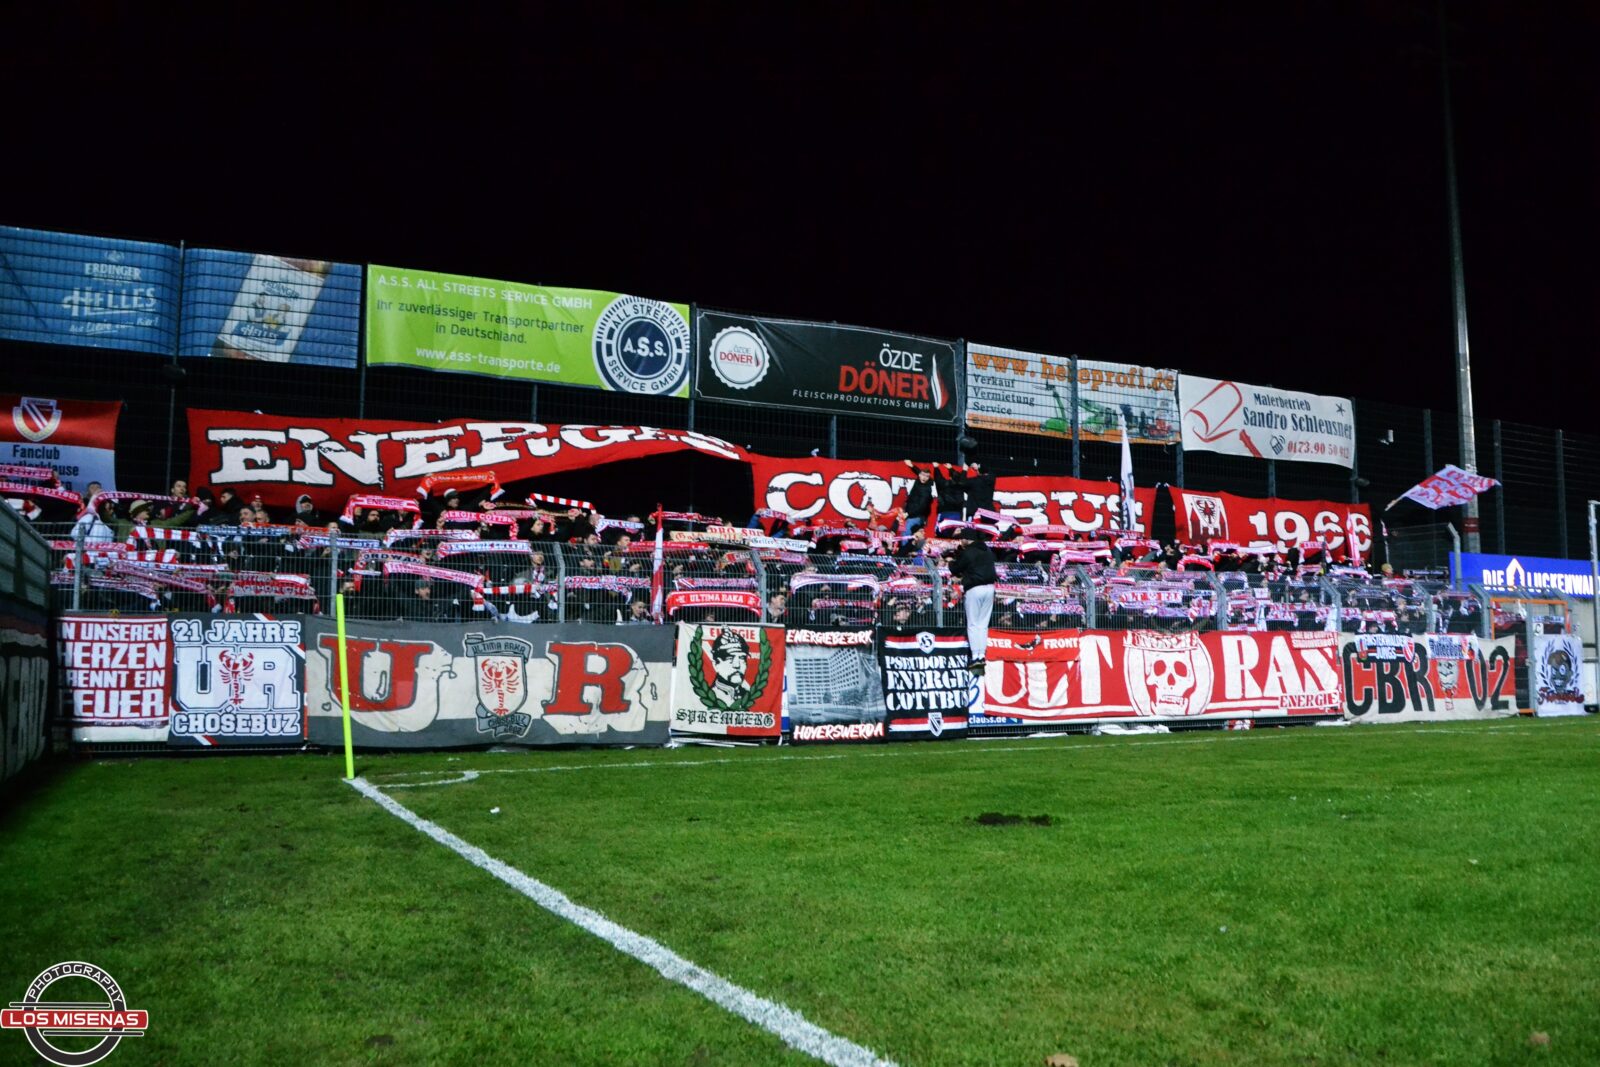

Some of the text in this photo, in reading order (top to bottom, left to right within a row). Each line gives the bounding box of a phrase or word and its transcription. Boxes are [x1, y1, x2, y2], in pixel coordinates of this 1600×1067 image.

[84, 263, 141, 280] ERDINGER
[62, 286, 157, 316] HELLES
[378, 274, 593, 310] A.S.S. ALL STREETS SERVICE GMBH
[376, 299, 585, 334] Ihr zuverlässiger Transportpartner
[612, 304, 679, 337] ALL STREETS
[435, 322, 527, 344] in Deutschland.
[623, 336, 668, 358] A.S.S.
[879, 343, 924, 372] ÖZDE
[415, 346, 561, 374] www.ass-transporte.de
[608, 359, 679, 392] SERVICE GMBH
[838, 361, 930, 400] DÖNER
[971, 352, 1175, 392] www.heeprofi.de
[973, 373, 1015, 388] Verkauf
[792, 389, 930, 410] FLEISCHPRODUKTIONS GMBH
[973, 387, 1035, 407] Vermietung
[973, 401, 1012, 415] Service
[1253, 393, 1312, 411] Malerbetrieb
[1243, 407, 1352, 440] Sandro Schleusner
[12, 444, 60, 460] Fanclub
[207, 422, 741, 489] ENERGIE
[765, 470, 1145, 532] COBUS
[1249, 510, 1372, 554] 1966
[1482, 569, 1600, 596] DIE LUCKENWAL
[689, 593, 744, 604] ULTIMA RAKA
[81, 621, 167, 641] UNSEREN
[173, 619, 300, 644] 21 JAHRE
[709, 627, 756, 641] EGIE
[786, 629, 873, 646] ENERGIEBEZIRK
[1043, 637, 1079, 649] FRONT
[58, 642, 167, 670] HERZEN
[57, 669, 166, 688] RENNT EIN
[1342, 642, 1436, 717] CBR
[1279, 692, 1340, 708] ENERGIE
[793, 723, 885, 741] HOYERSWERDA
